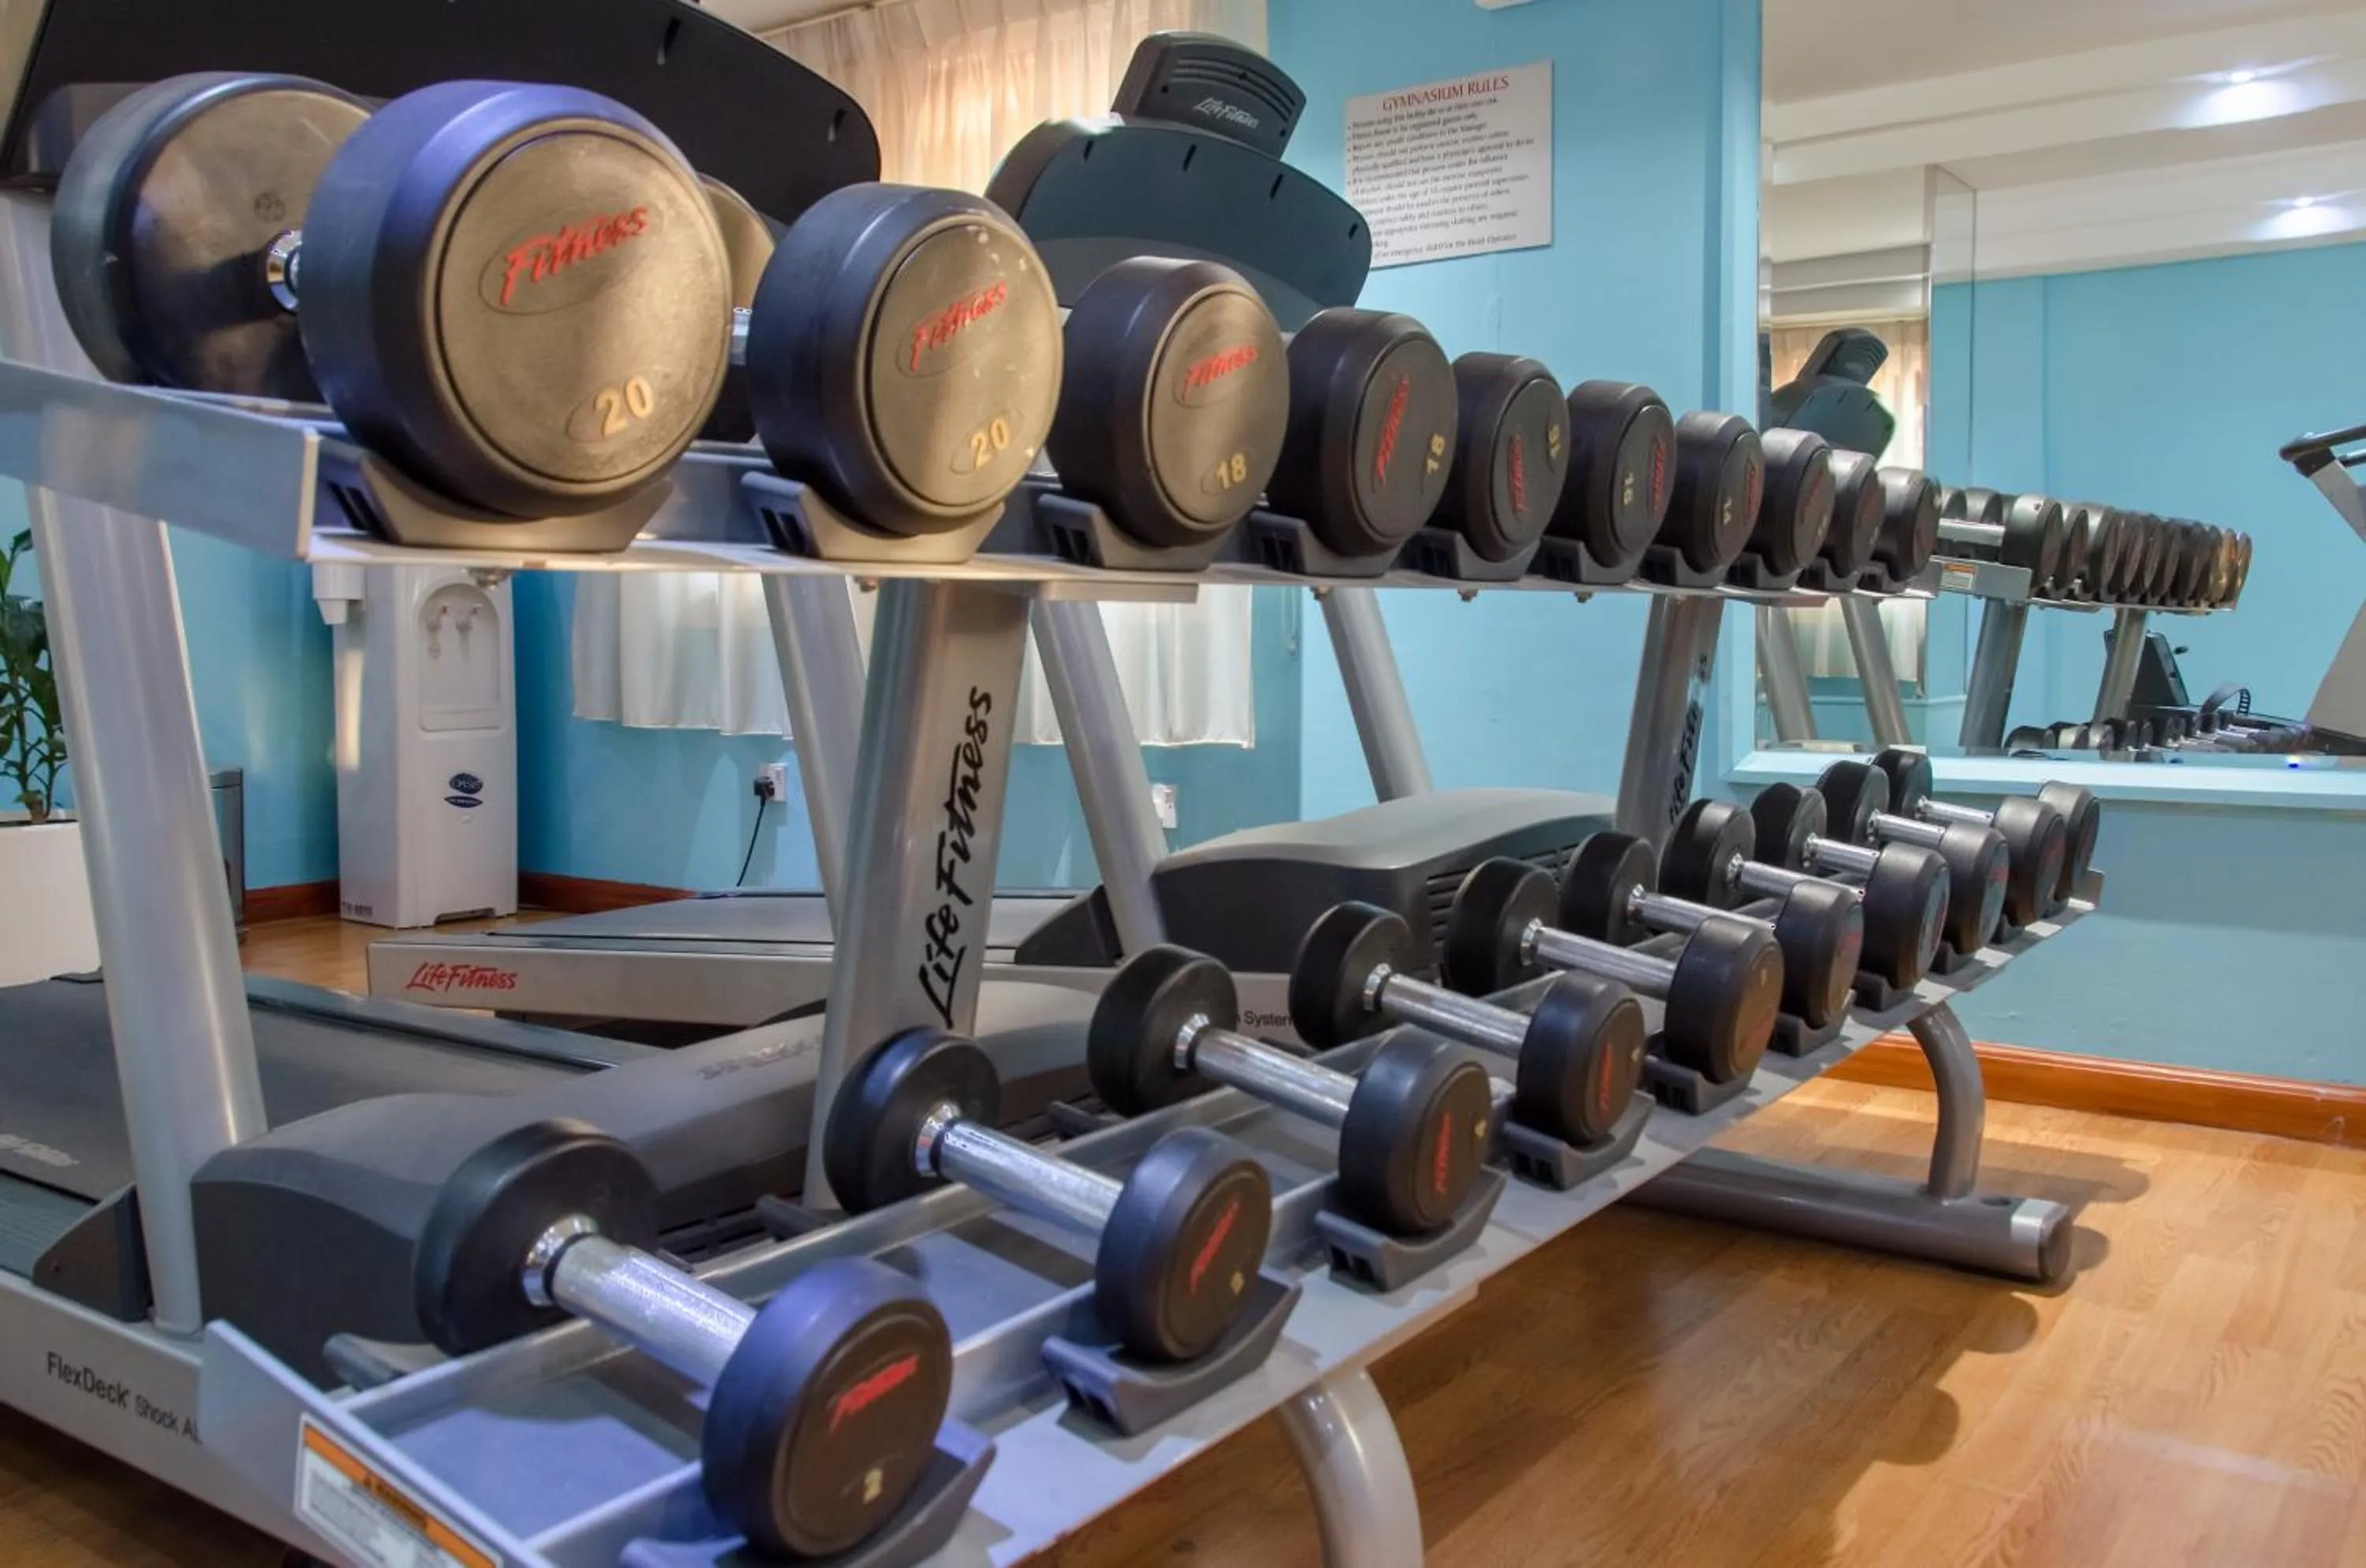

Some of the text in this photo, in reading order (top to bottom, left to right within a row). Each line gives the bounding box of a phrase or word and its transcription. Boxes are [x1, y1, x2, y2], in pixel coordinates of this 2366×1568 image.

[1383, 85, 1464, 111] GYMNASIUM
[1468, 76, 1510, 95] RULES
[592, 374, 653, 438] 20
[970, 417, 1009, 470] 20
[1216, 453, 1247, 491] 18
[47, 1351, 129, 1409] FlexDeck
[136, 1394, 180, 1433] Shock
